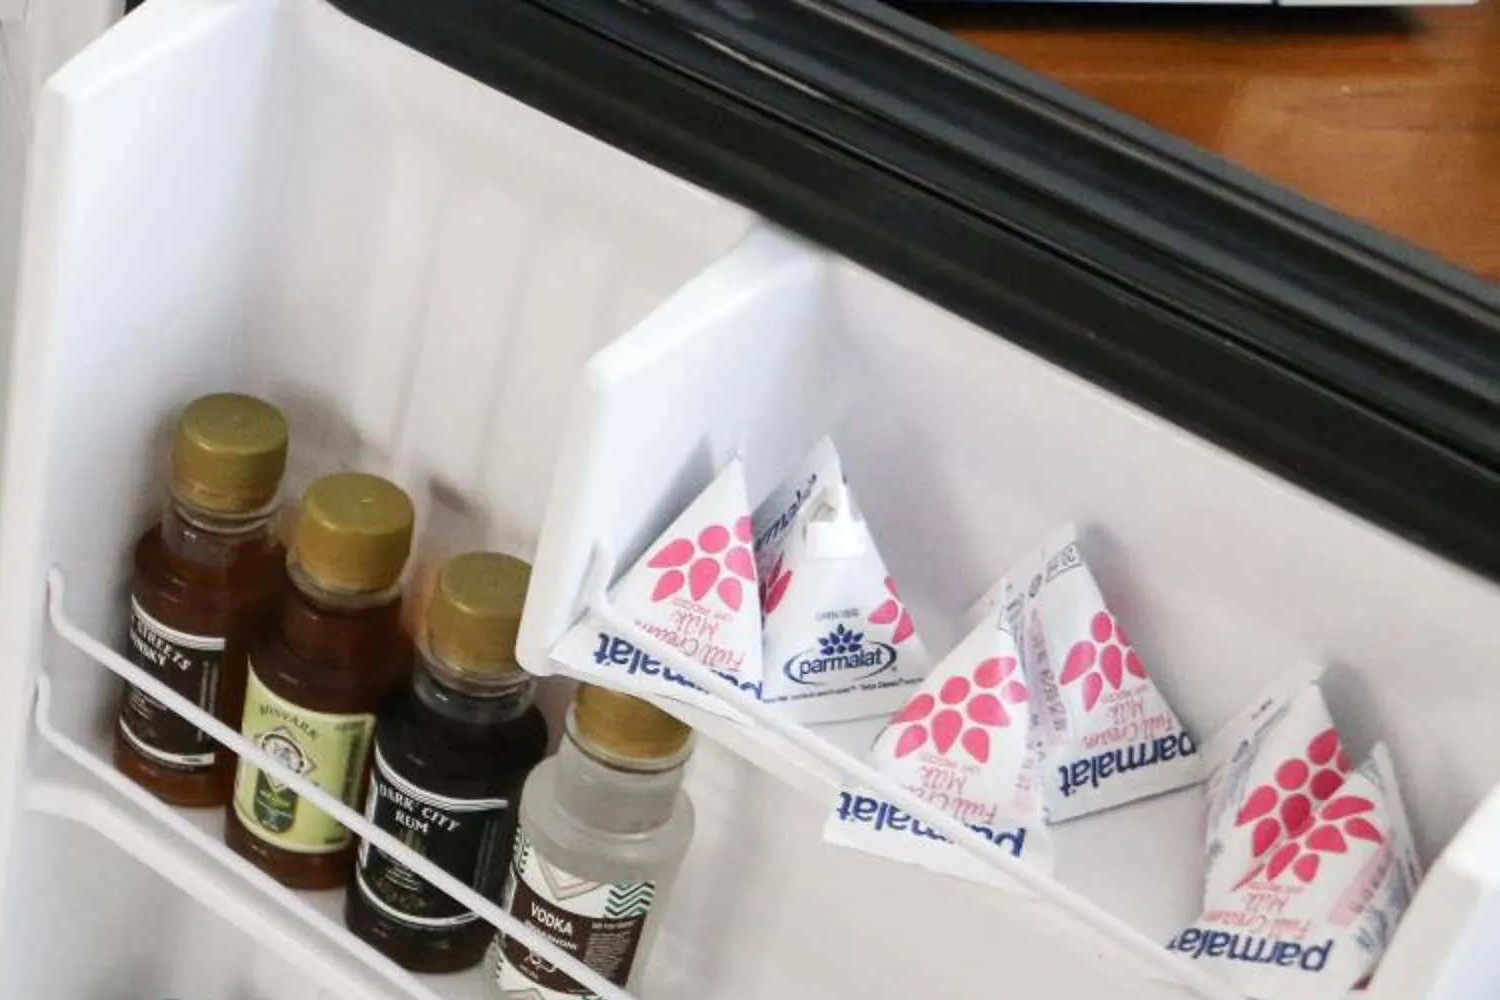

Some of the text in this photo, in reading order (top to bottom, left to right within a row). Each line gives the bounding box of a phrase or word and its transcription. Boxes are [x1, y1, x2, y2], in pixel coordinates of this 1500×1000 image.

[799, 648, 884, 680] parmalat
[377, 783, 462, 833] DARK CITY
[394, 810, 431, 834] RUM
[530, 902, 575, 937] VODKA
